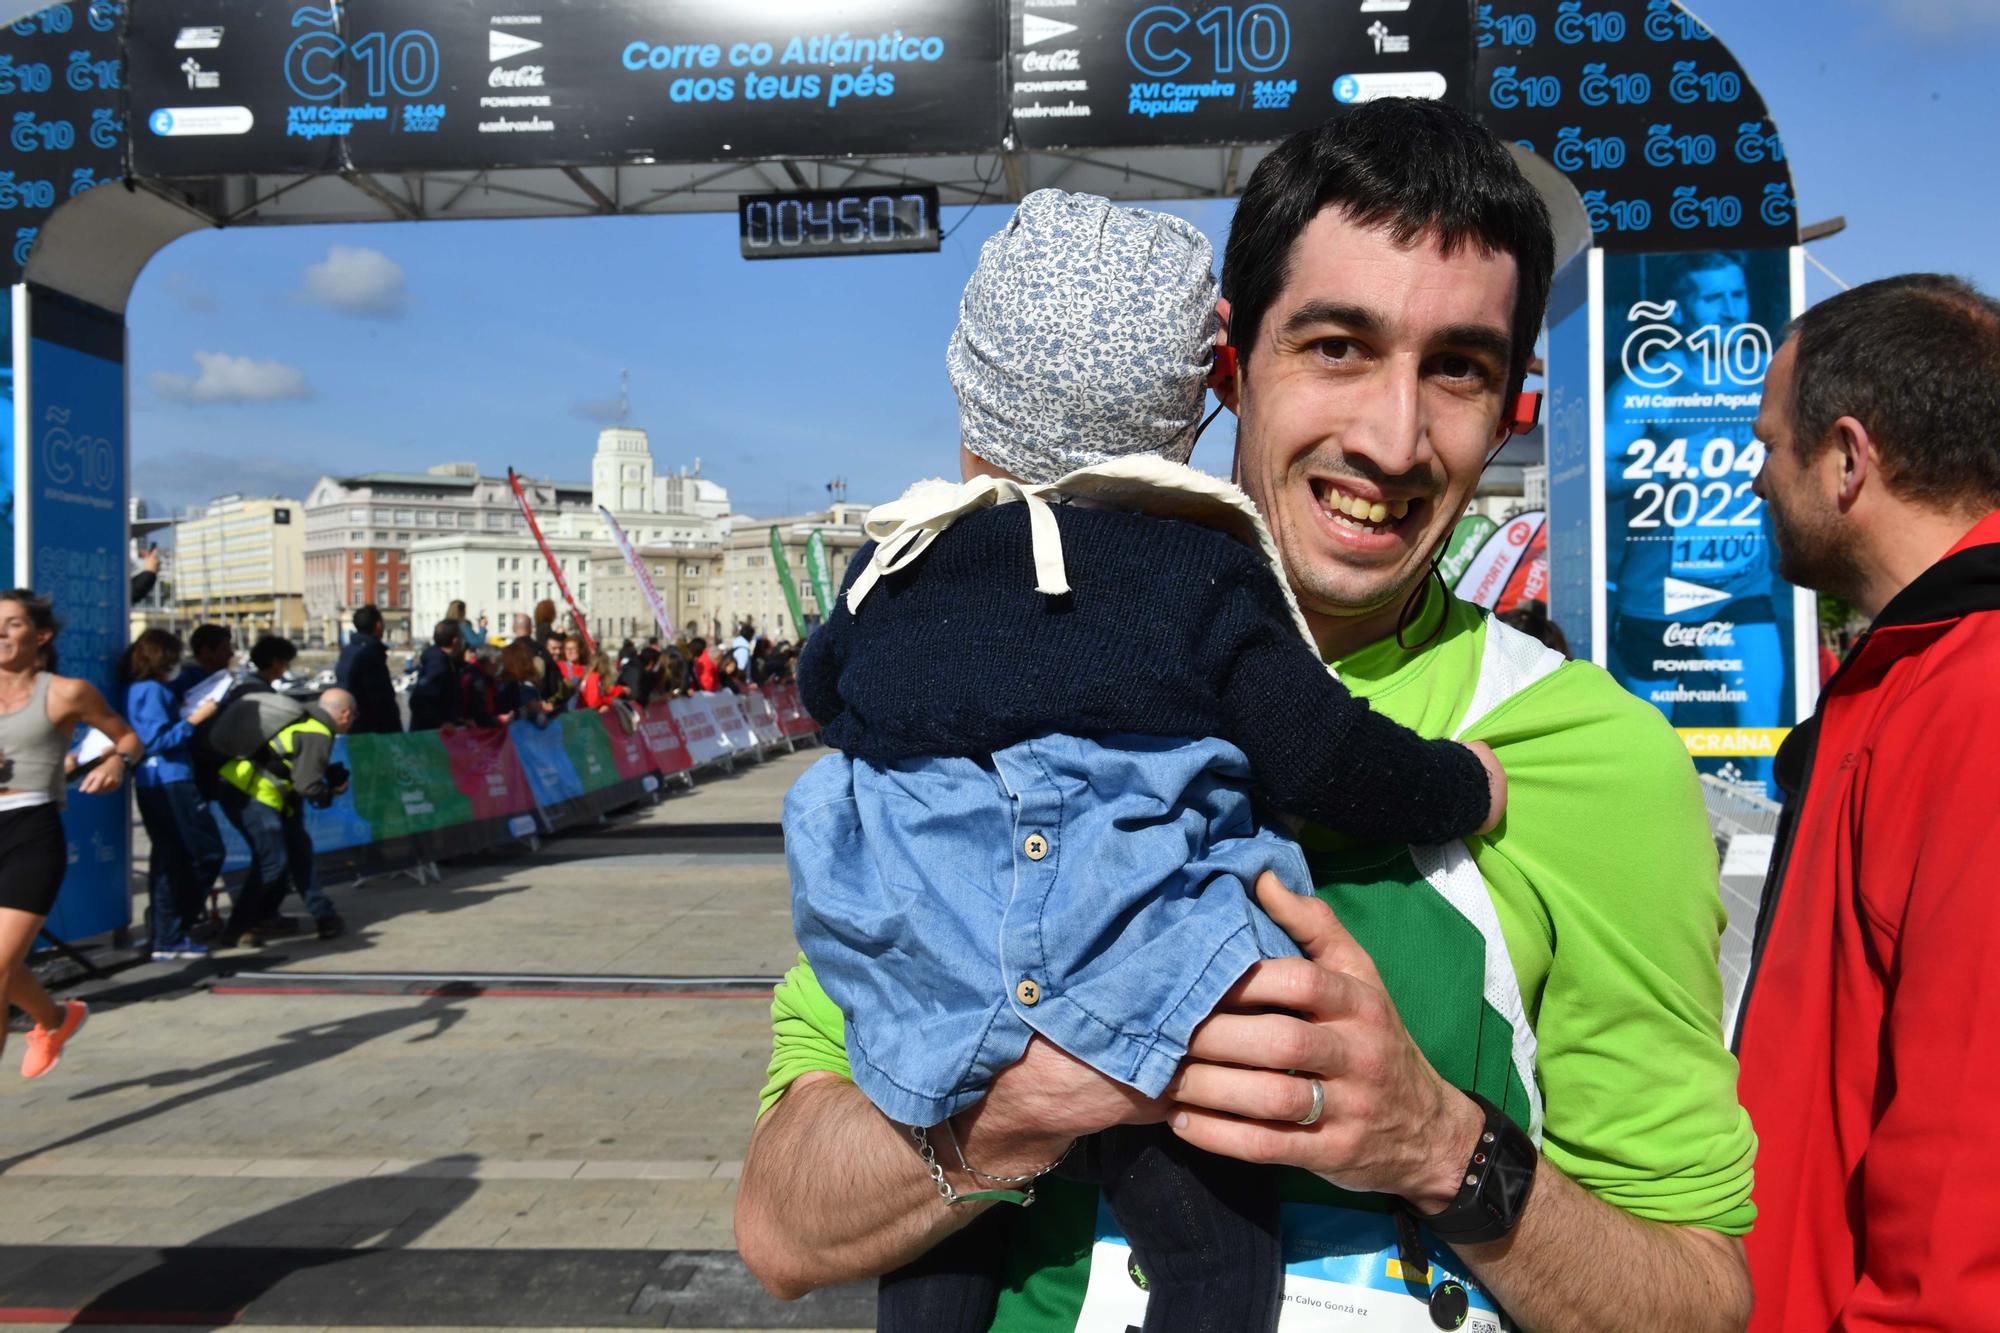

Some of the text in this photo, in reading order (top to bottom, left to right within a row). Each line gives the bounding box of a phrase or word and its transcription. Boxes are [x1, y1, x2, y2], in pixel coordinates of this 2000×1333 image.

[622, 30, 945, 71] Corre co Atlántico
[669, 64, 896, 108] aos teus pés
[1129, 80, 1236, 99] XVI Carreira
[1252, 80, 1298, 96] 24.04
[1128, 97, 1200, 118] Popular
[1252, 94, 1290, 109] 2022
[287, 103, 388, 122] XVI Carreira
[403, 104, 447, 120] 24.04
[287, 120, 353, 142] Popular
[1624, 395, 1650, 409] XVI
[1651, 392, 1712, 408] Carreira
[1623, 437, 1767, 480] 24.04
[1628, 481, 1762, 528] 2022
[1296, 1295, 1322, 1308] Calvo
